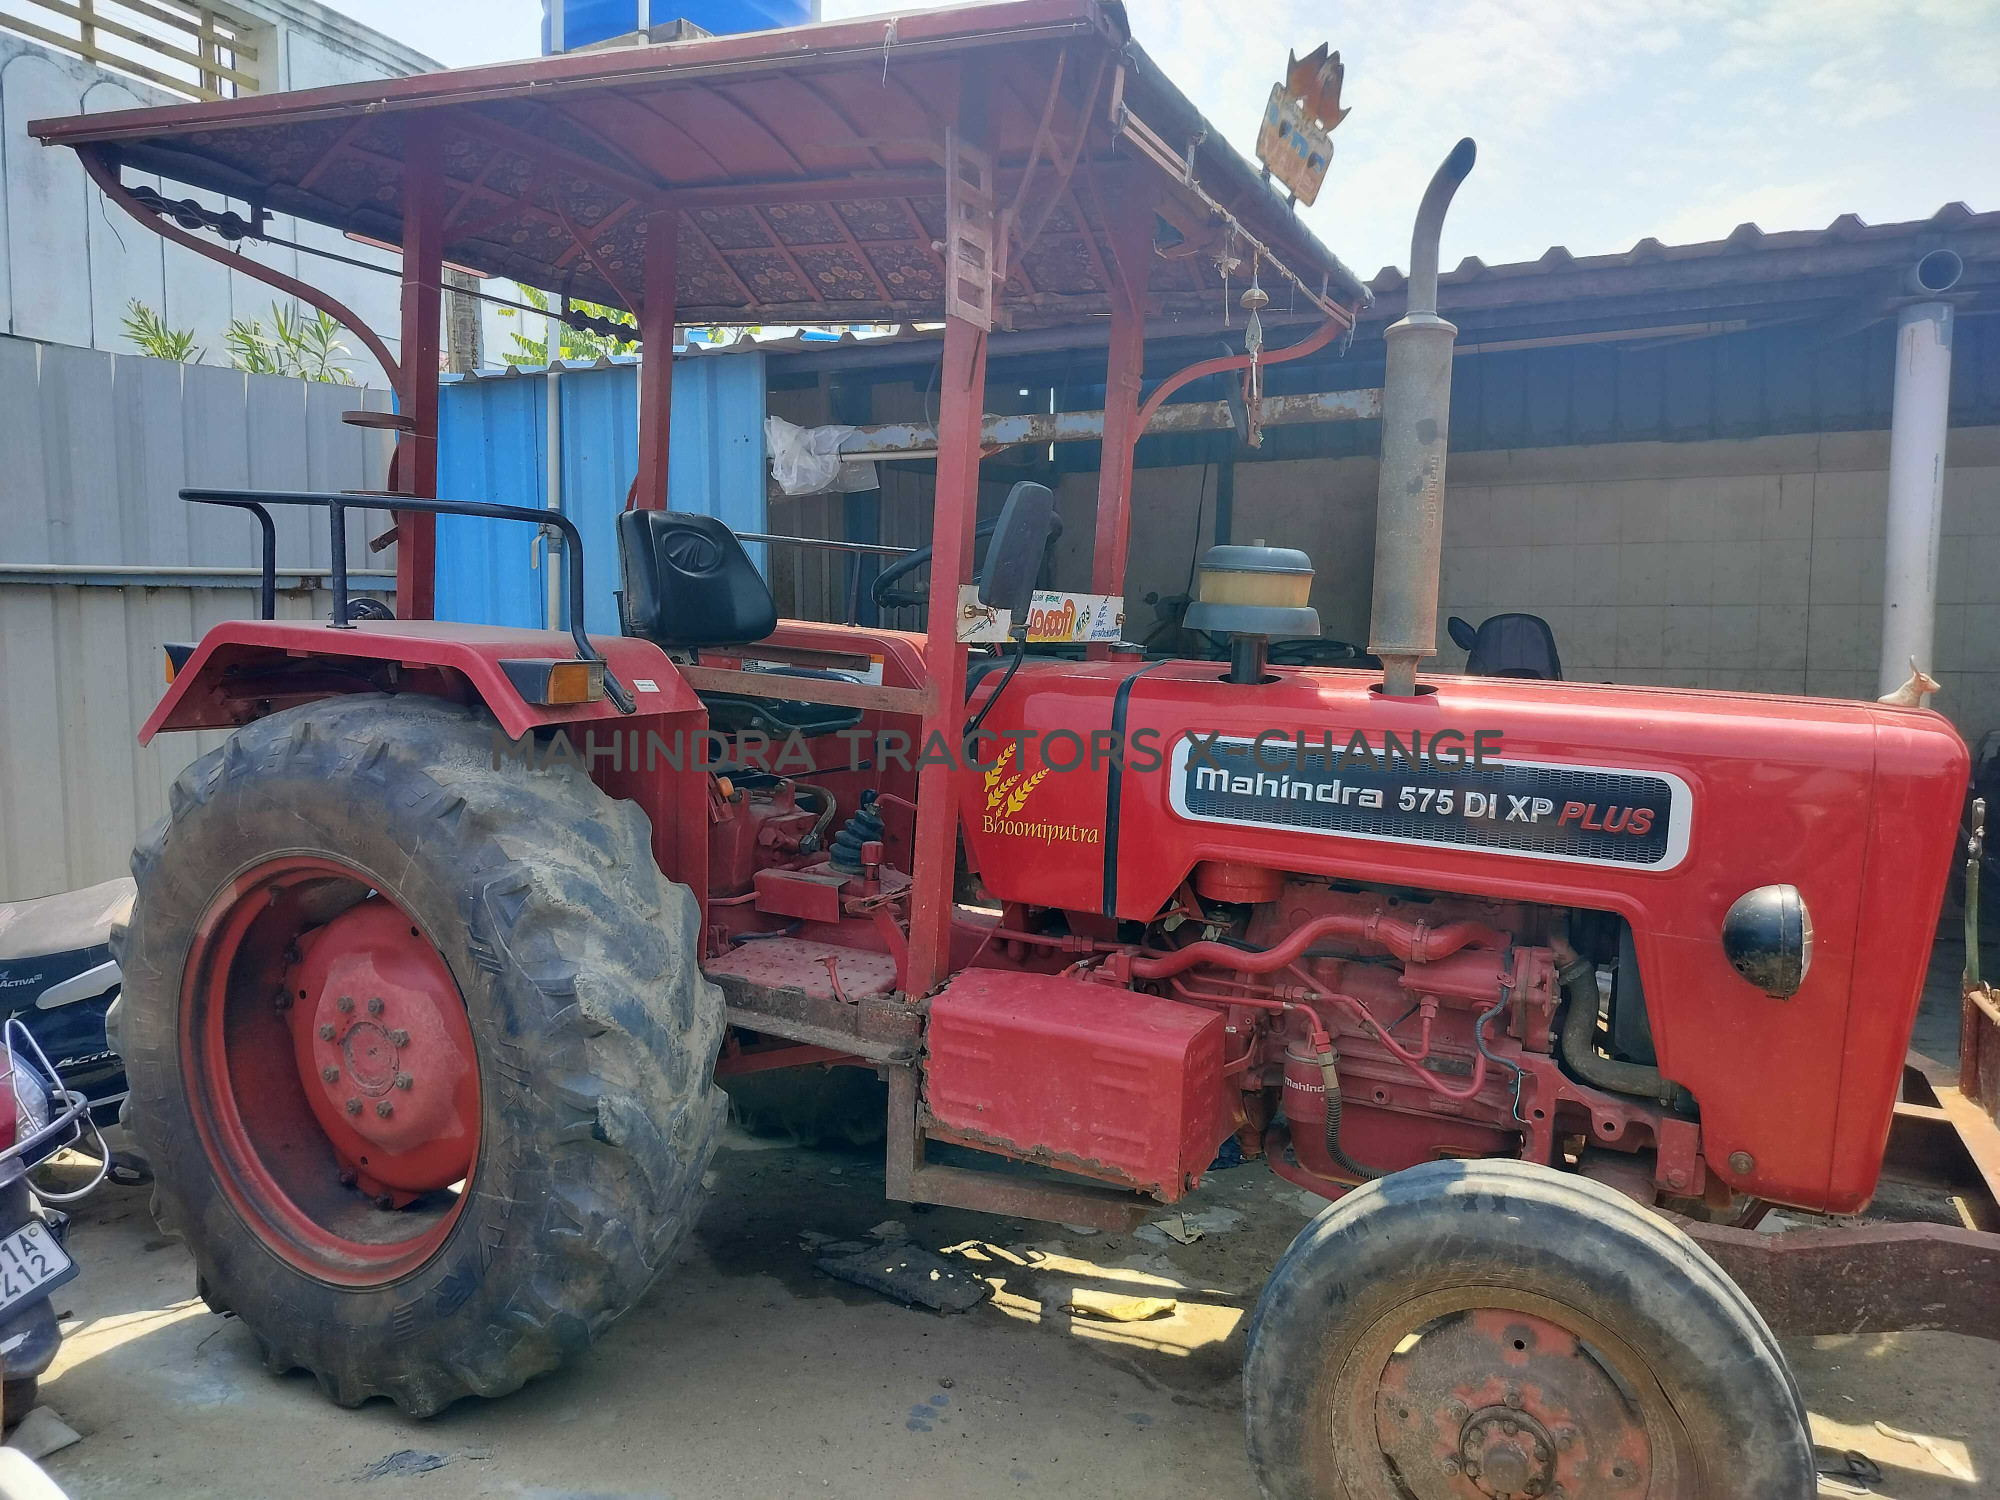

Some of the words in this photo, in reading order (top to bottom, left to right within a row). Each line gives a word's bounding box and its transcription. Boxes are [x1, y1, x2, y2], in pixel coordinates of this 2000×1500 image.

[982, 805, 1099, 846] Bhoomiputra
[1398, 785, 1455, 816] 575
[1463, 790, 1498, 821] DI
[1507, 793, 1555, 825] XP
[1556, 801, 1655, 836] PLUS
[1284, 1076, 1325, 1093] Mahind
[0, 1234, 38, 1270] 1A
[0, 1254, 54, 1302] 412
